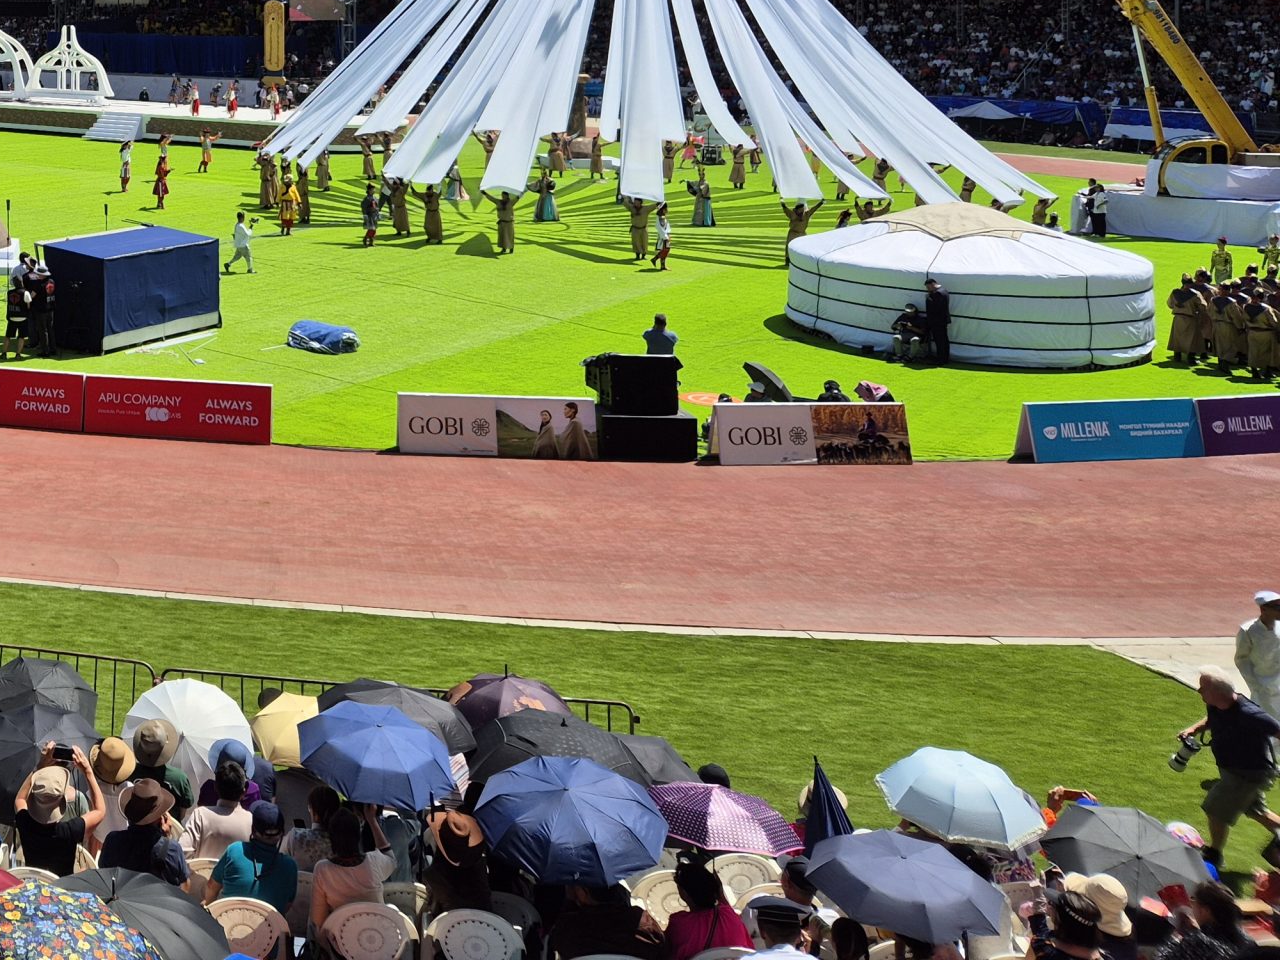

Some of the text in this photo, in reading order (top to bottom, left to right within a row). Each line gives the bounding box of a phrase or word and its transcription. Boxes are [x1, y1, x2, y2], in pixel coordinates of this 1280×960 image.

[21, 386, 65, 399] ALWAYS
[98, 392, 182, 408] APU COMPANY
[14, 400, 71, 414] FORWARD
[205, 399, 253, 411] ALWAYS
[198, 412, 260, 427] FORWARD
[408, 415, 464, 436] GOBI
[1227, 415, 1274, 433] MILLENIA
[728, 426, 782, 446] GOBI
[1060, 421, 1111, 439] MILLENIA
